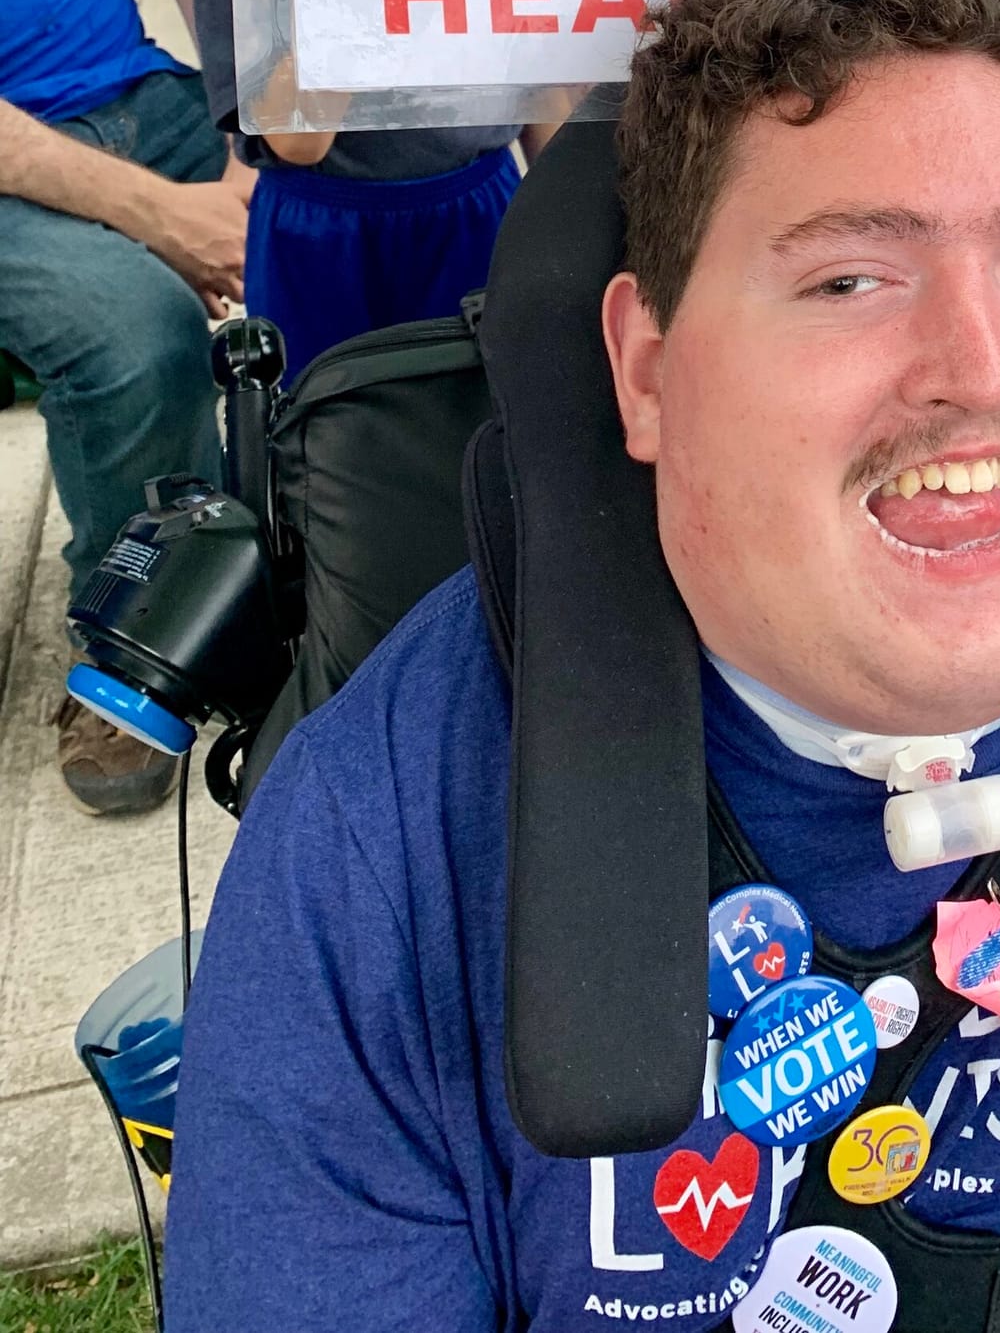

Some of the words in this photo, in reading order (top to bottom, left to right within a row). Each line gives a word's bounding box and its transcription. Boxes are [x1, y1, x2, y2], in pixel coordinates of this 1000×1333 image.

[725, 889, 761, 904] Complex
[734, 1015, 805, 1070] WHEN
[804, 990, 844, 1028] WE
[885, 1018, 911, 1038] RIGHTS
[736, 1010, 869, 1115] VOTE
[766, 1099, 813, 1140] WE
[811, 1063, 867, 1113] WIN
[796, 1254, 873, 1320] WORK
[815, 1238, 883, 1294] MEANINGFUL
[583, 1275, 750, 1321] Advocating
